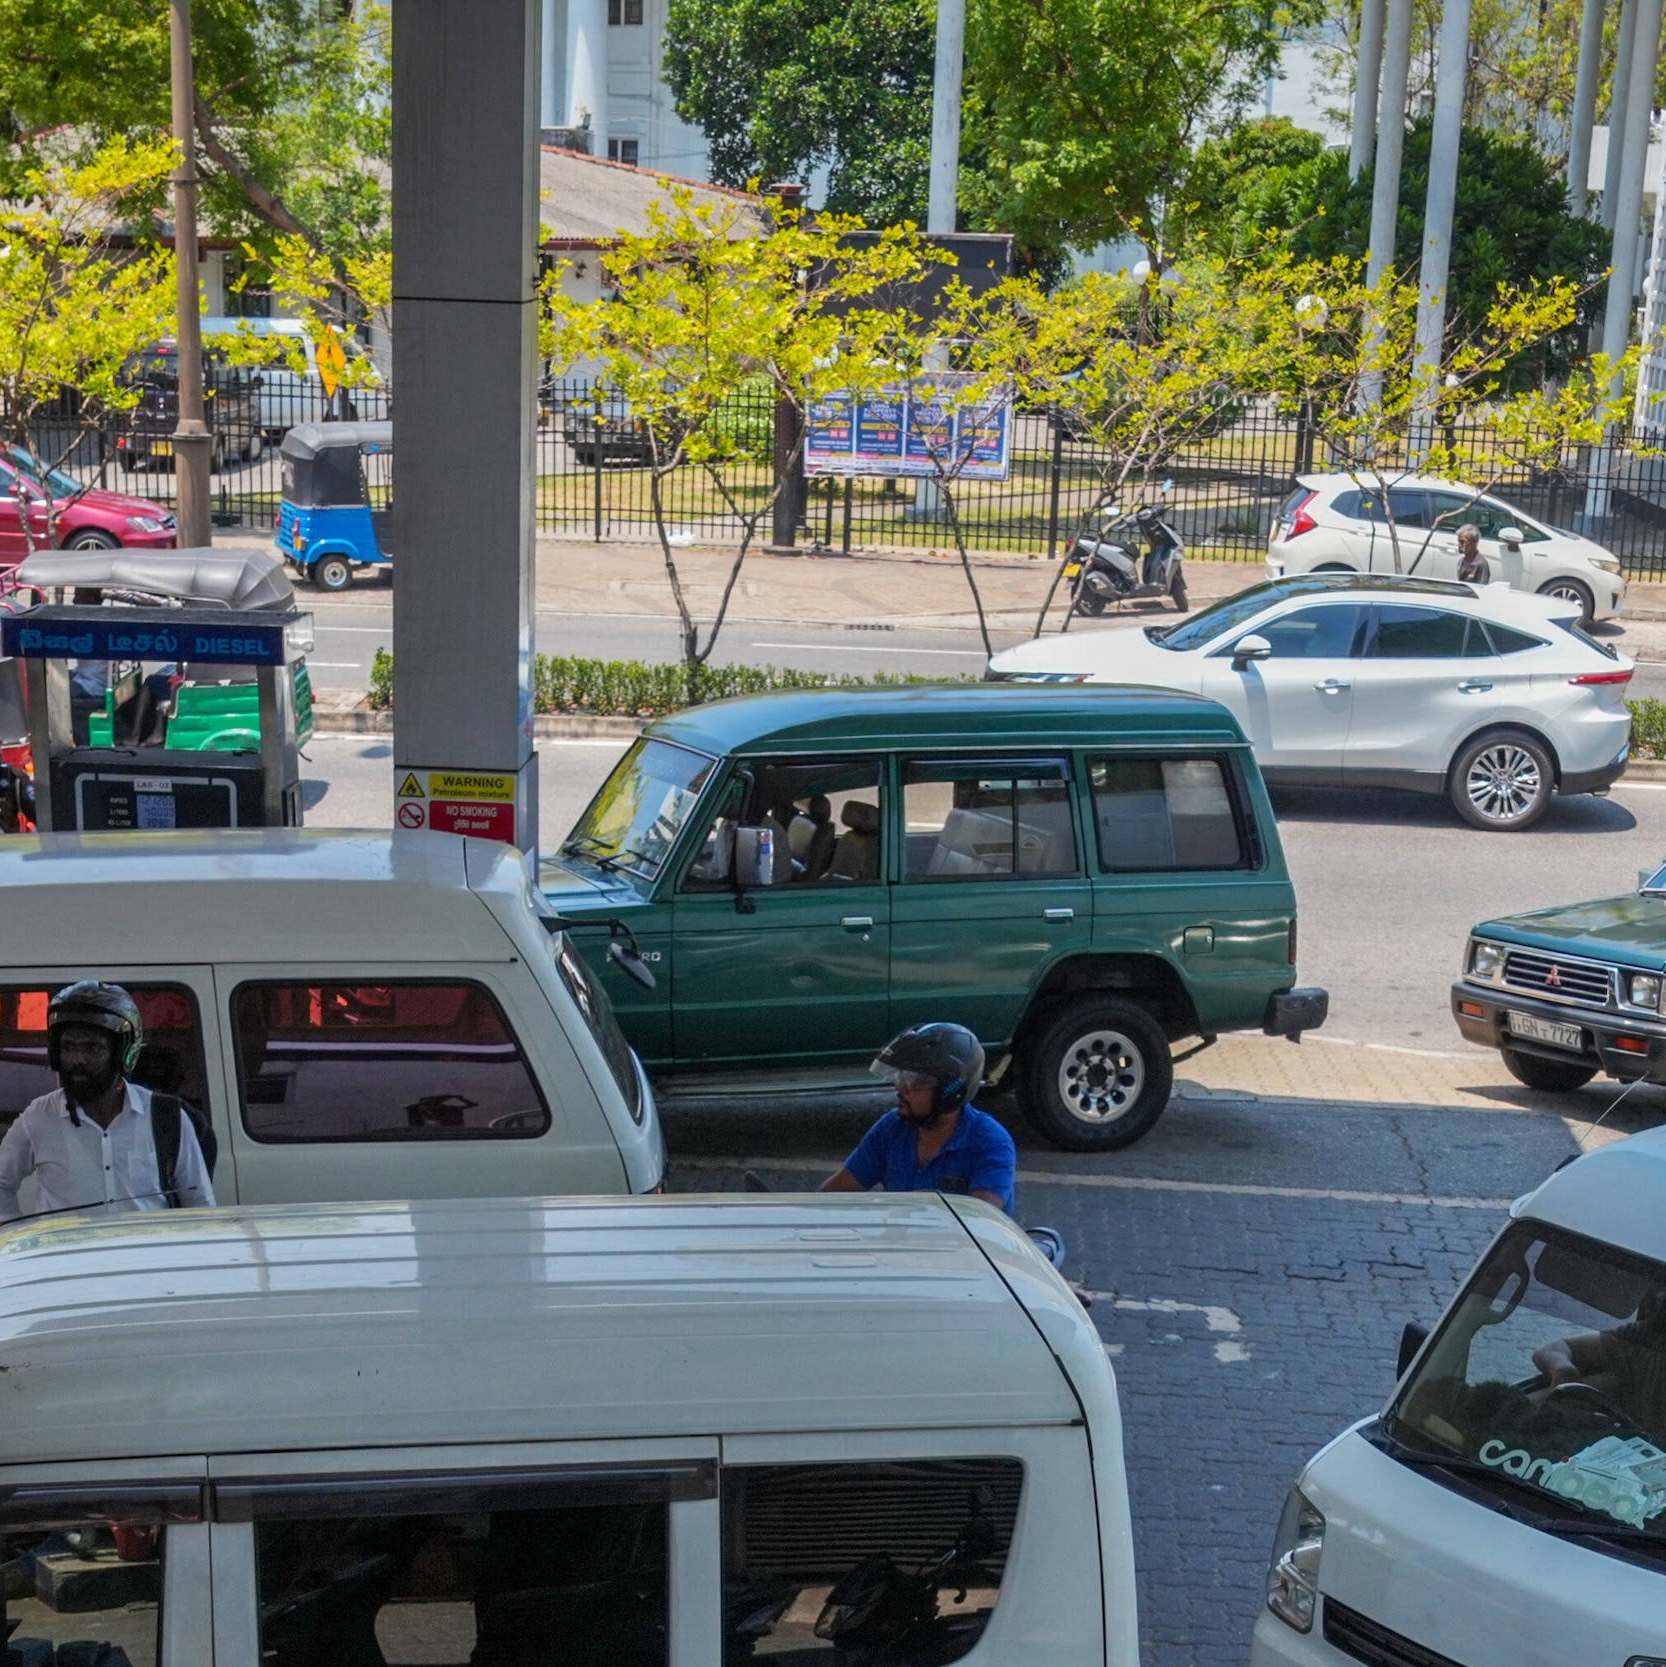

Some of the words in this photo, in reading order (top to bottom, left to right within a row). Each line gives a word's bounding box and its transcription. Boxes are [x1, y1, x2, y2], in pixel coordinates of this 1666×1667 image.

[195, 637, 270, 656] DIESEL
[443, 776, 504, 788] WARNING
[446, 805, 458, 816] NO
[460, 806, 497, 817] SMOKING
